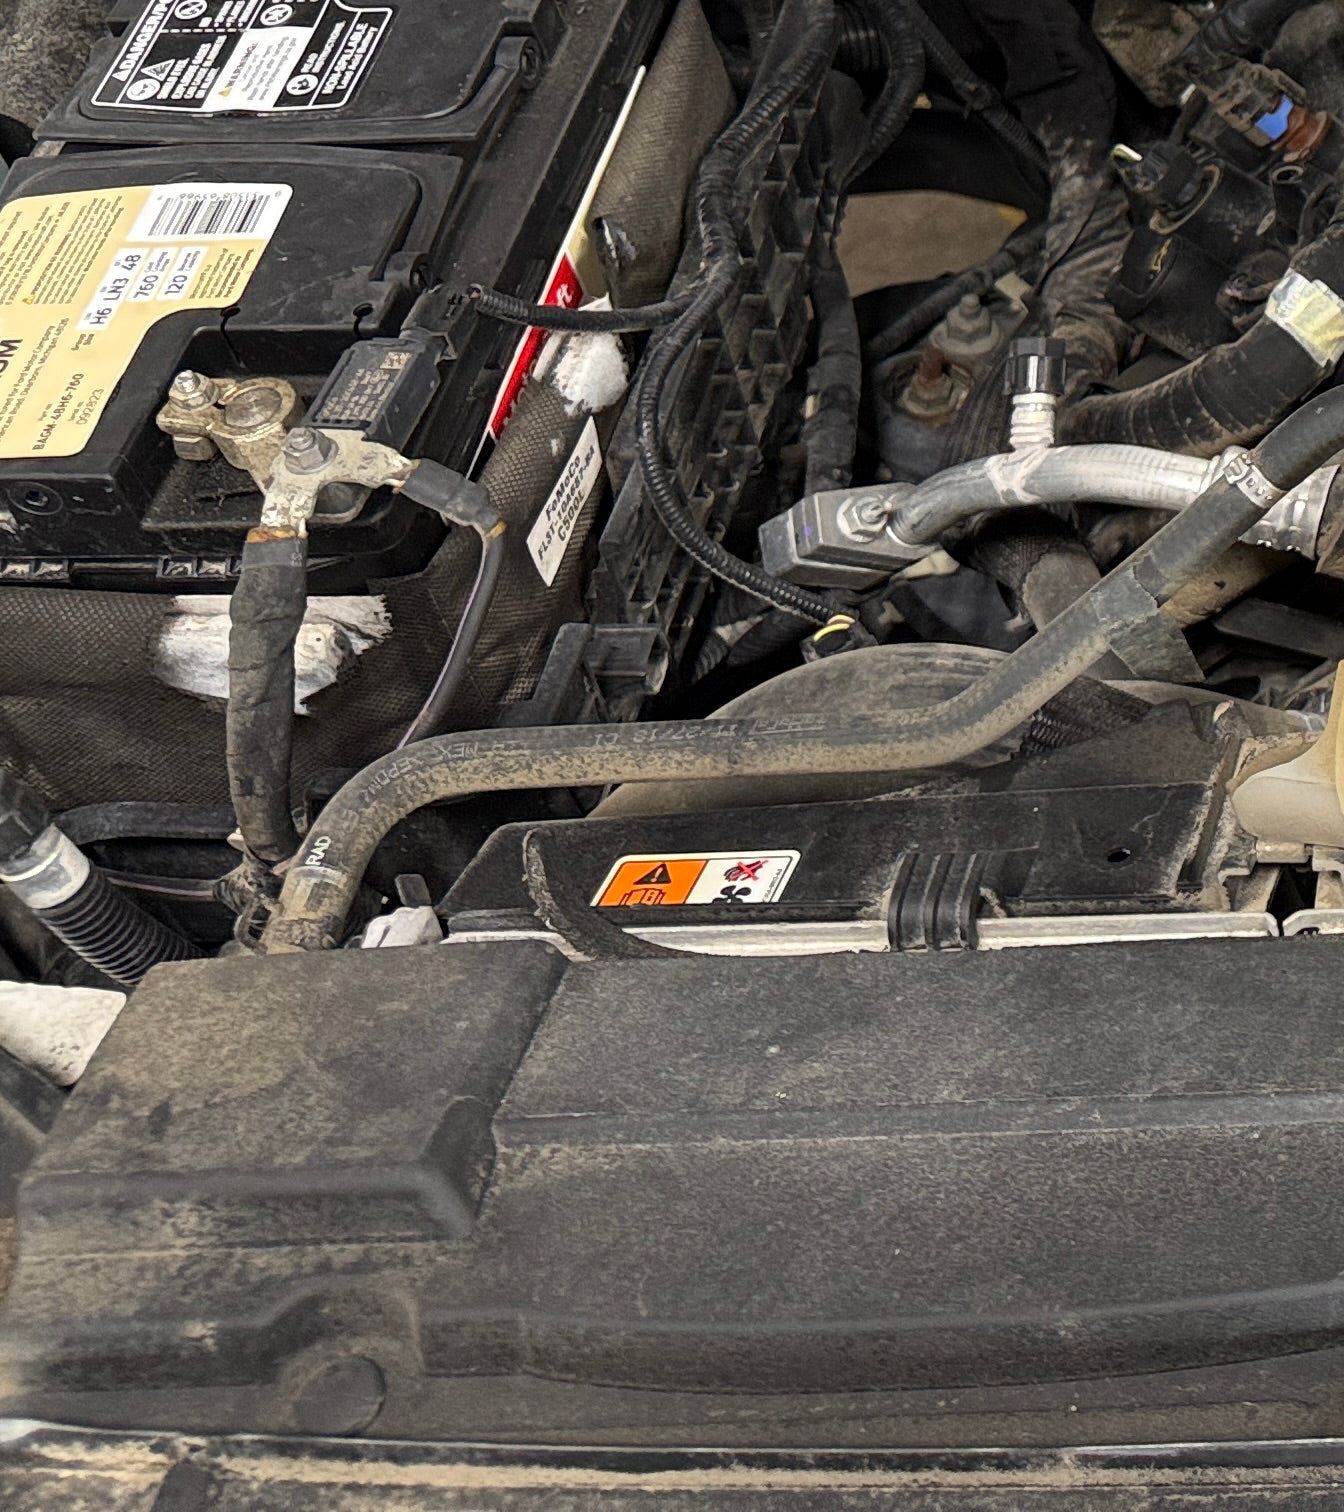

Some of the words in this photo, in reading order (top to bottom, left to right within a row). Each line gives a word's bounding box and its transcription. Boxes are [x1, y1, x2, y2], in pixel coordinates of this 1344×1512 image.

[89, 307, 113, 325] H6
[103, 278, 129, 301] LN3
[121, 254, 143, 272] 48
[134, 275, 159, 299] 760
[164, 274, 188, 296] 120
[544, 455, 581, 522] FoMoCo
[304, 835, 332, 866] RAD
